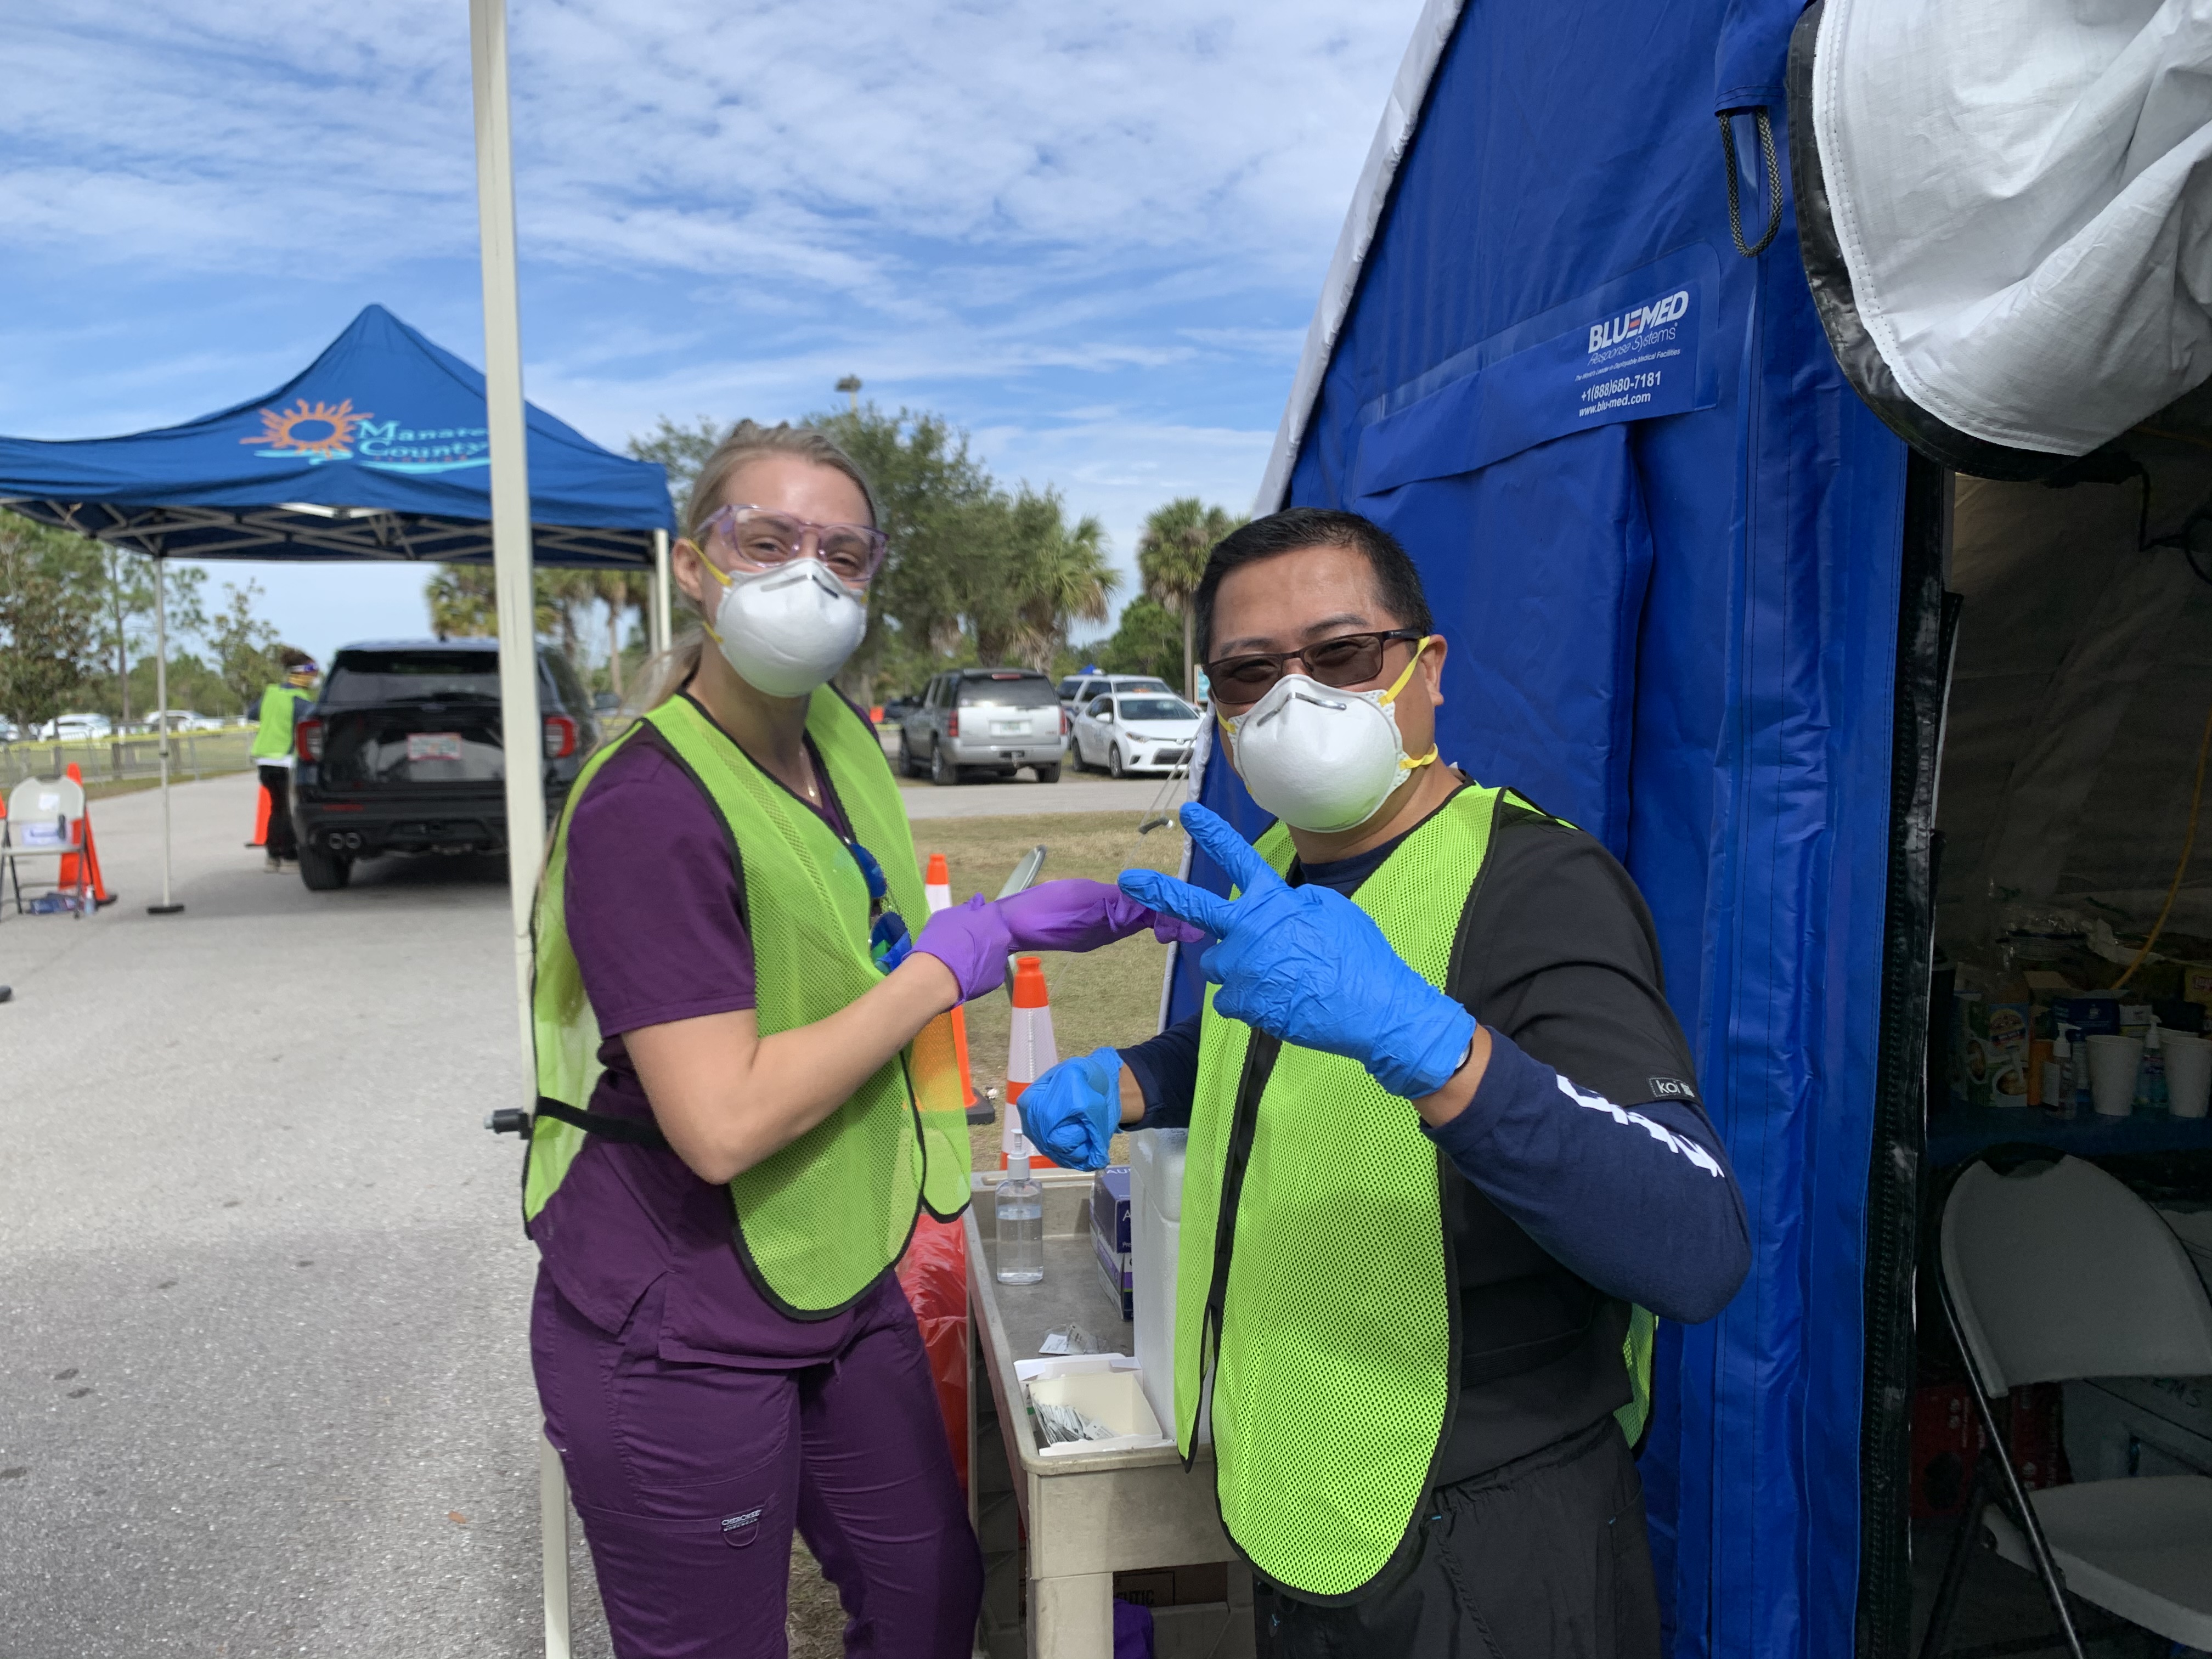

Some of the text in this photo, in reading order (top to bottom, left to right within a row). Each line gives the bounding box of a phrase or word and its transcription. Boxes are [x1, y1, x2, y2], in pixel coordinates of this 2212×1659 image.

[1587, 327, 1675, 366] Response Systems
[1656, 348, 1681, 359] Facilities
[1581, 371, 1661, 402] +1(888)680-7181
[1579, 392, 1651, 417] www.blu-med.com
[356, 420, 488, 442] Manate
[359, 439, 488, 458] County
[1656, 1080, 1681, 1094] koi
